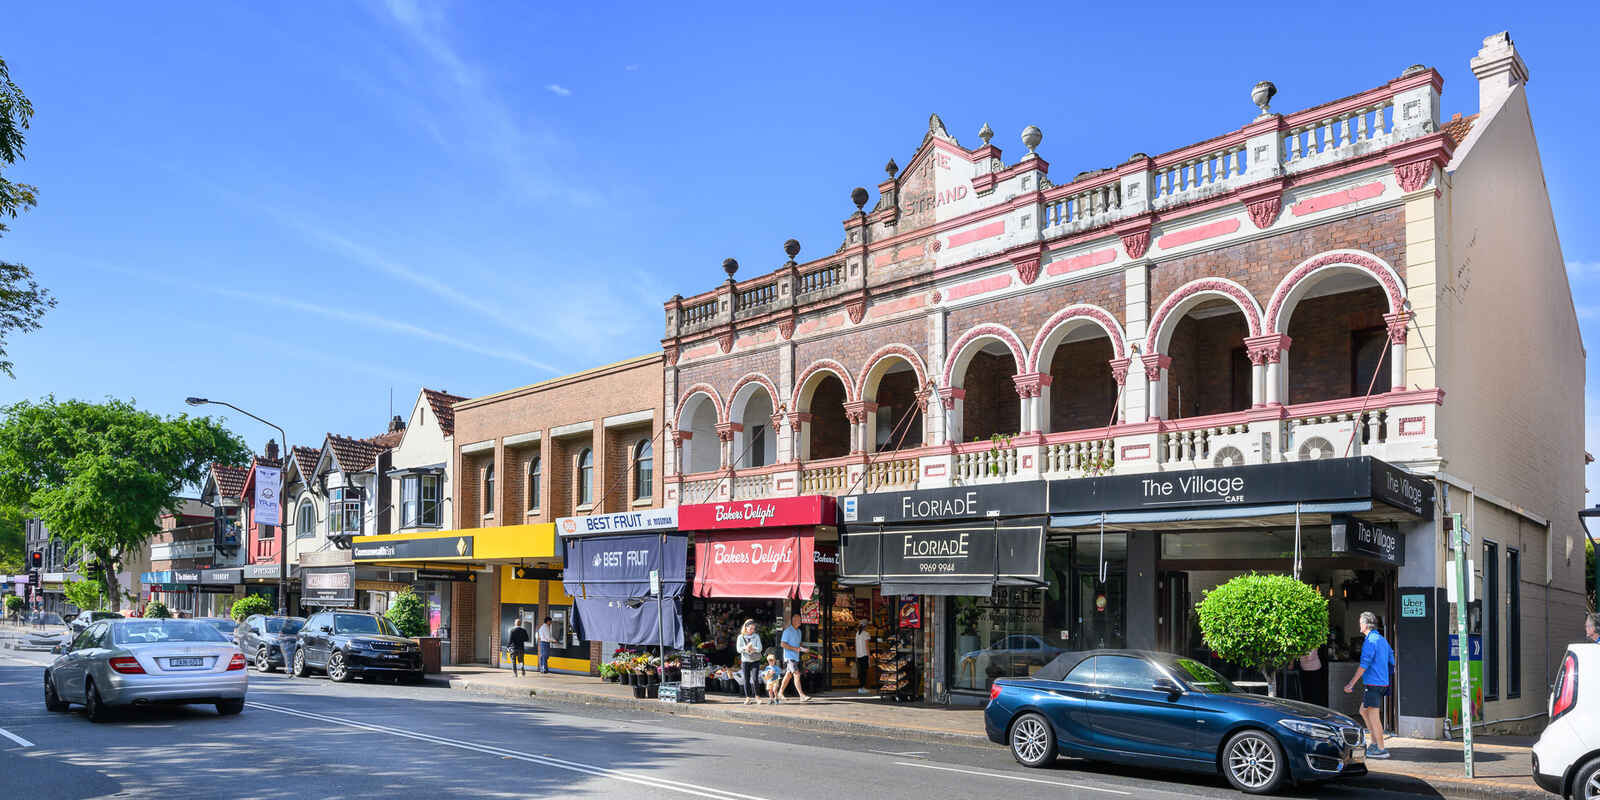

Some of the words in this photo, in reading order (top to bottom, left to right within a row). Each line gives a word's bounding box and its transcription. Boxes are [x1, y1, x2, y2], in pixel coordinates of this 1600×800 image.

[903, 185, 968, 216] STRAND
[1142, 479, 1173, 497] The
[1179, 475, 1244, 496] Village
[1385, 471, 1399, 493] The
[1400, 478, 1422, 505] Village
[715, 504, 743, 522] Bakers
[743, 503, 776, 526] Delight
[903, 491, 977, 518] FLORIADE
[587, 516, 610, 531] BEST
[613, 513, 642, 529] FRUIT
[904, 533, 969, 556] FLORIADE
[1357, 522, 1371, 543] The
[1372, 527, 1396, 553] Village
[603, 551, 623, 567] BEST
[626, 550, 649, 567] FRUIT
[714, 543, 750, 565] Bakers
[751, 543, 793, 573] Delight
[814, 551, 834, 564] Bakers
[1403, 599, 1424, 607] Uber
